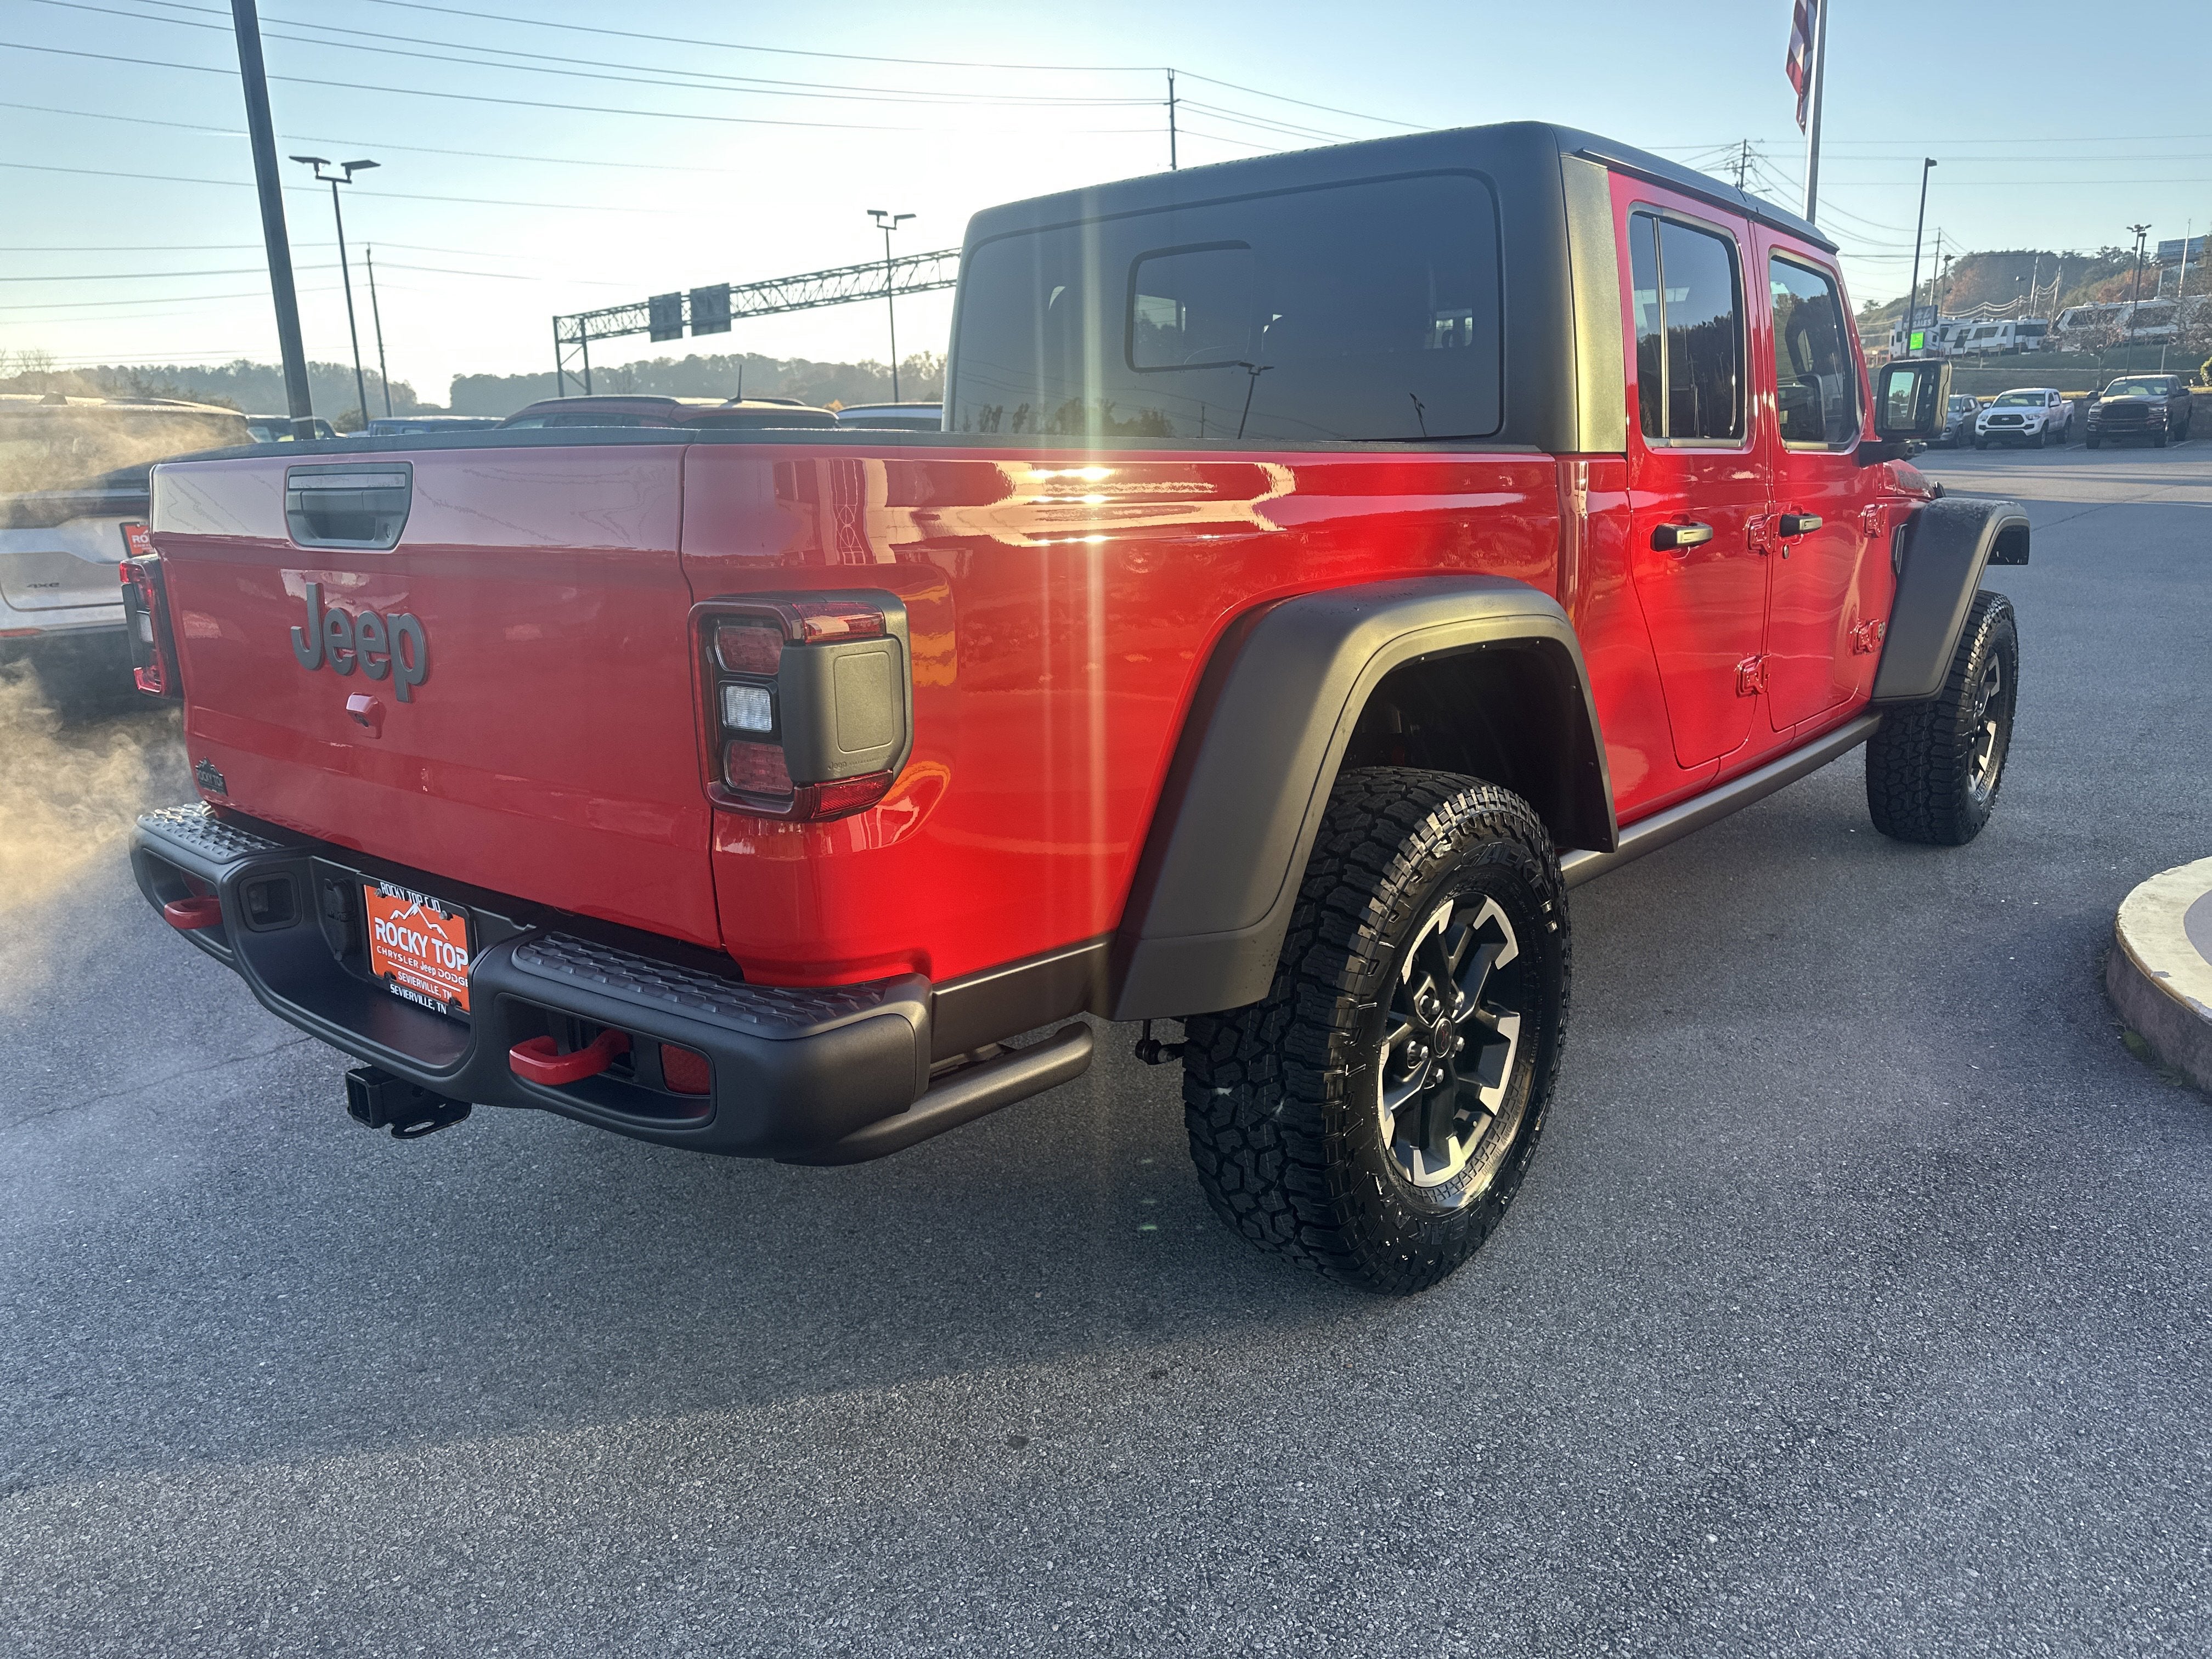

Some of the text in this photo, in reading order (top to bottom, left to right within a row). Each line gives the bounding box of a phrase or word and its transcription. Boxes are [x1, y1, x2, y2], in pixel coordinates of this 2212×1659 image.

[1913, 319, 1931, 328] SALES
[291, 582, 430, 703] Jeep
[380, 882, 442, 913] ROCKY TOP CJD
[374, 917, 469, 972] ROCKY TOP
[377, 945, 419, 967] CHRYSLER
[420, 961, 436, 976] Jeep
[390, 984, 447, 1014] SEVIERVILLE, TN
[398, 971, 452, 1000] SEVIERVILLE, TN
